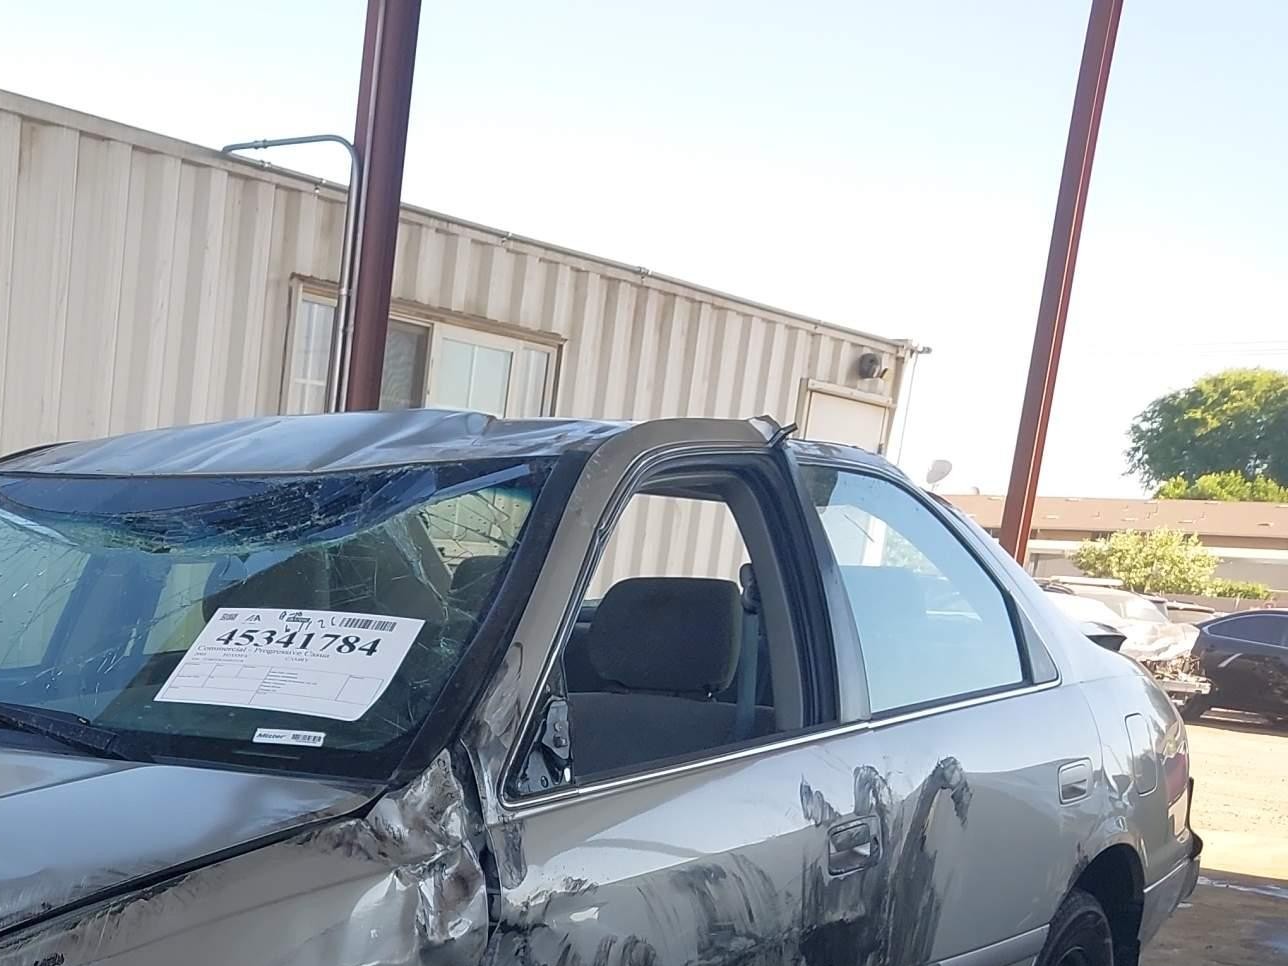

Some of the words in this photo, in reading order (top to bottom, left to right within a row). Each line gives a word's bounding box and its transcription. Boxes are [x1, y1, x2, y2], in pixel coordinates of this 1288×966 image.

[197, 645, 247, 653] Commercial
[253, 647, 303, 656] Progressive
[215, 628, 382, 656] 45341784
